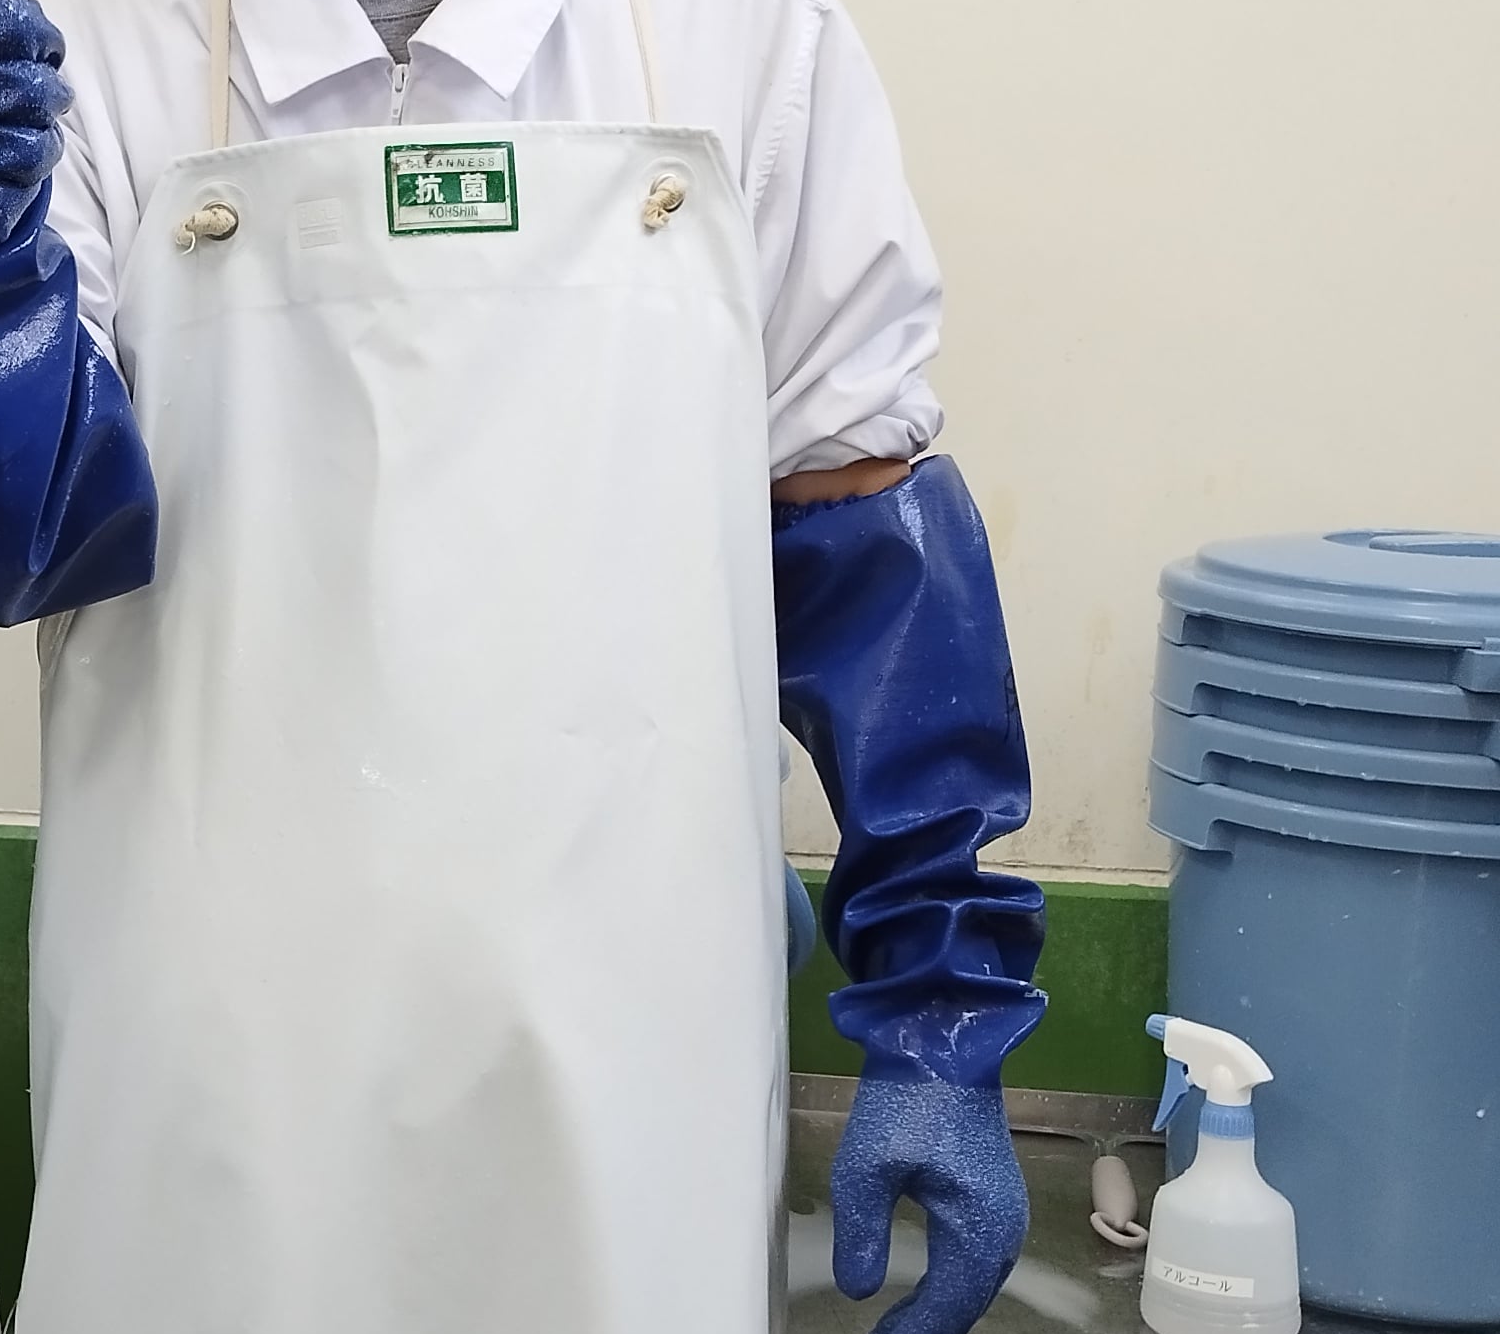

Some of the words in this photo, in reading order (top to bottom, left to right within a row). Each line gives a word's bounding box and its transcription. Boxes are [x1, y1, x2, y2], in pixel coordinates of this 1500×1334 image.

[416, 173, 488, 203] 抗菌
[428, 206, 479, 219] KOHSHIN
[1163, 1266, 1232, 1293] アルコール
